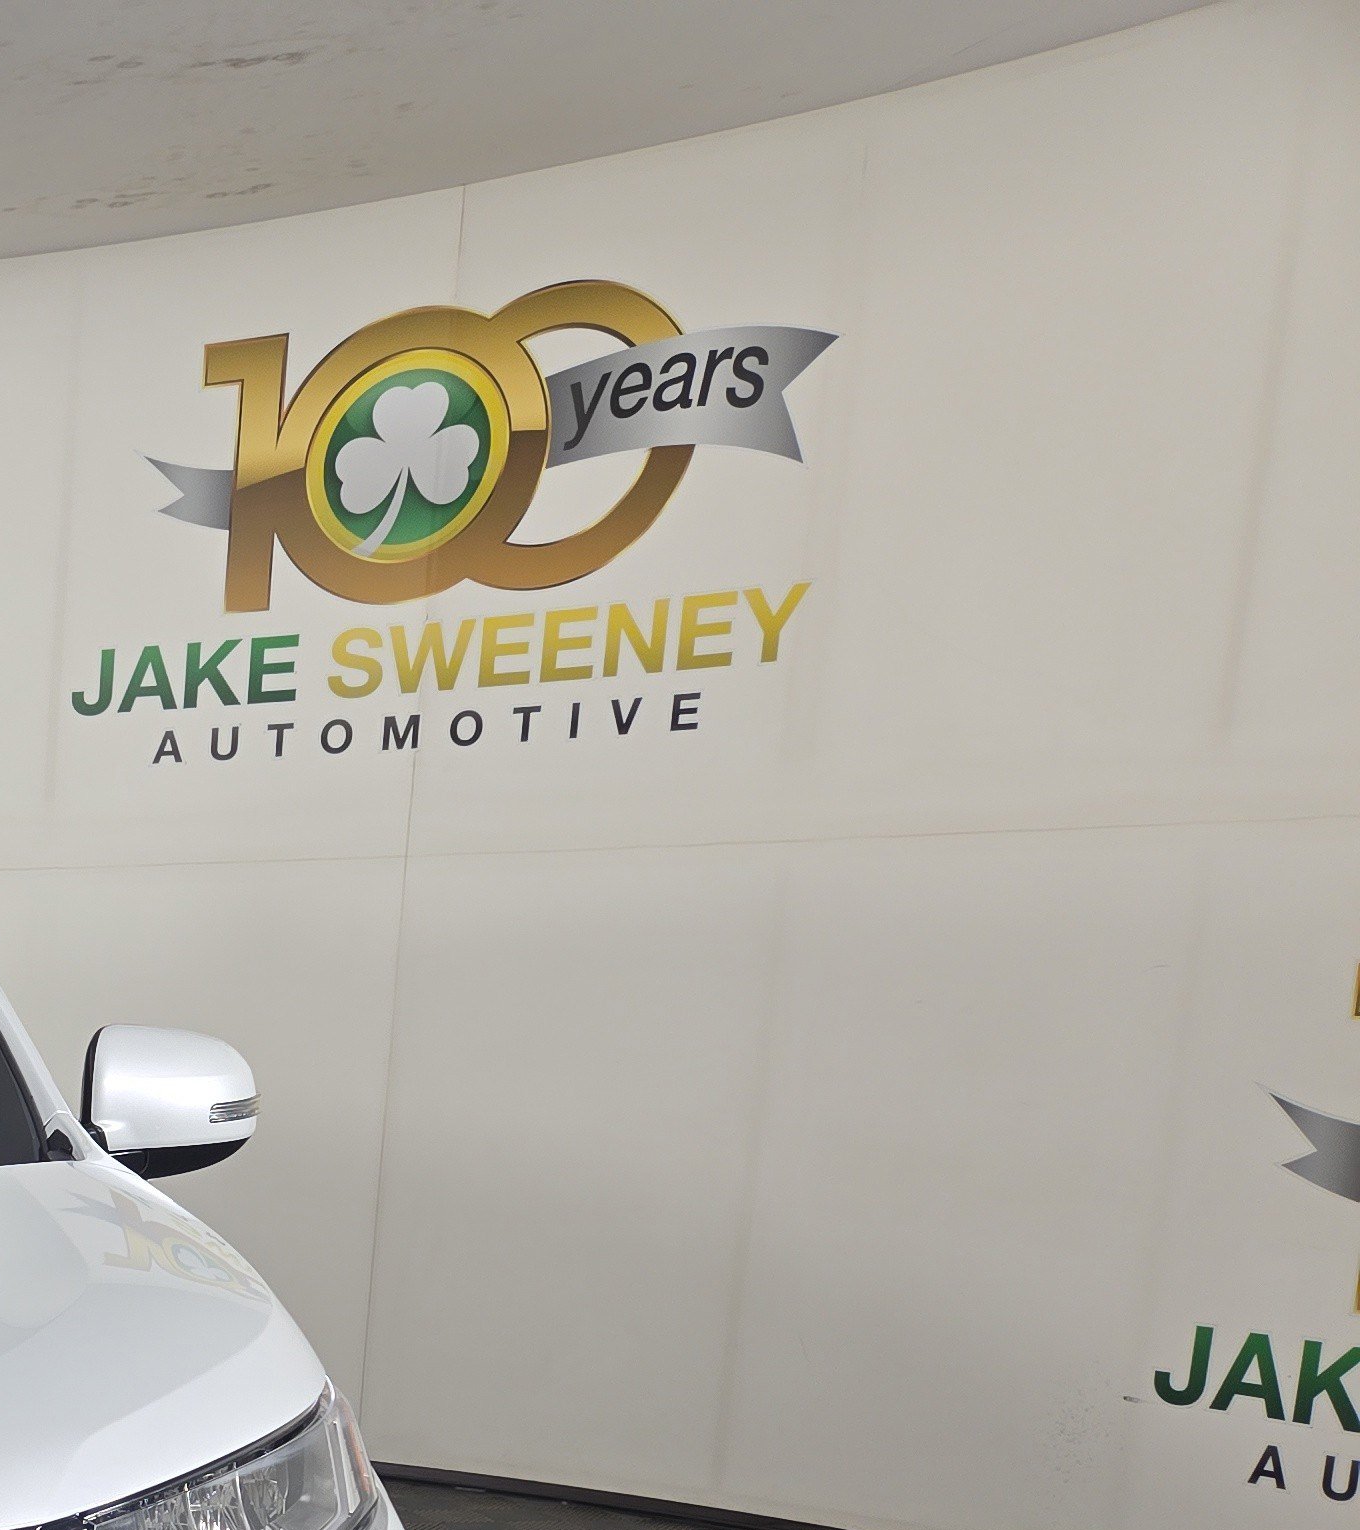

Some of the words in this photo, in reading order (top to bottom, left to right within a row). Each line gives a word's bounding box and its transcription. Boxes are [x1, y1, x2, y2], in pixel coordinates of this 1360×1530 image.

[202, 278, 697, 614] 100
[562, 337, 770, 451] years
[70, 633, 302, 718] JAKE
[326, 581, 812, 699] SWEENEY
[152, 692, 702, 766] AUTOMOTIVE
